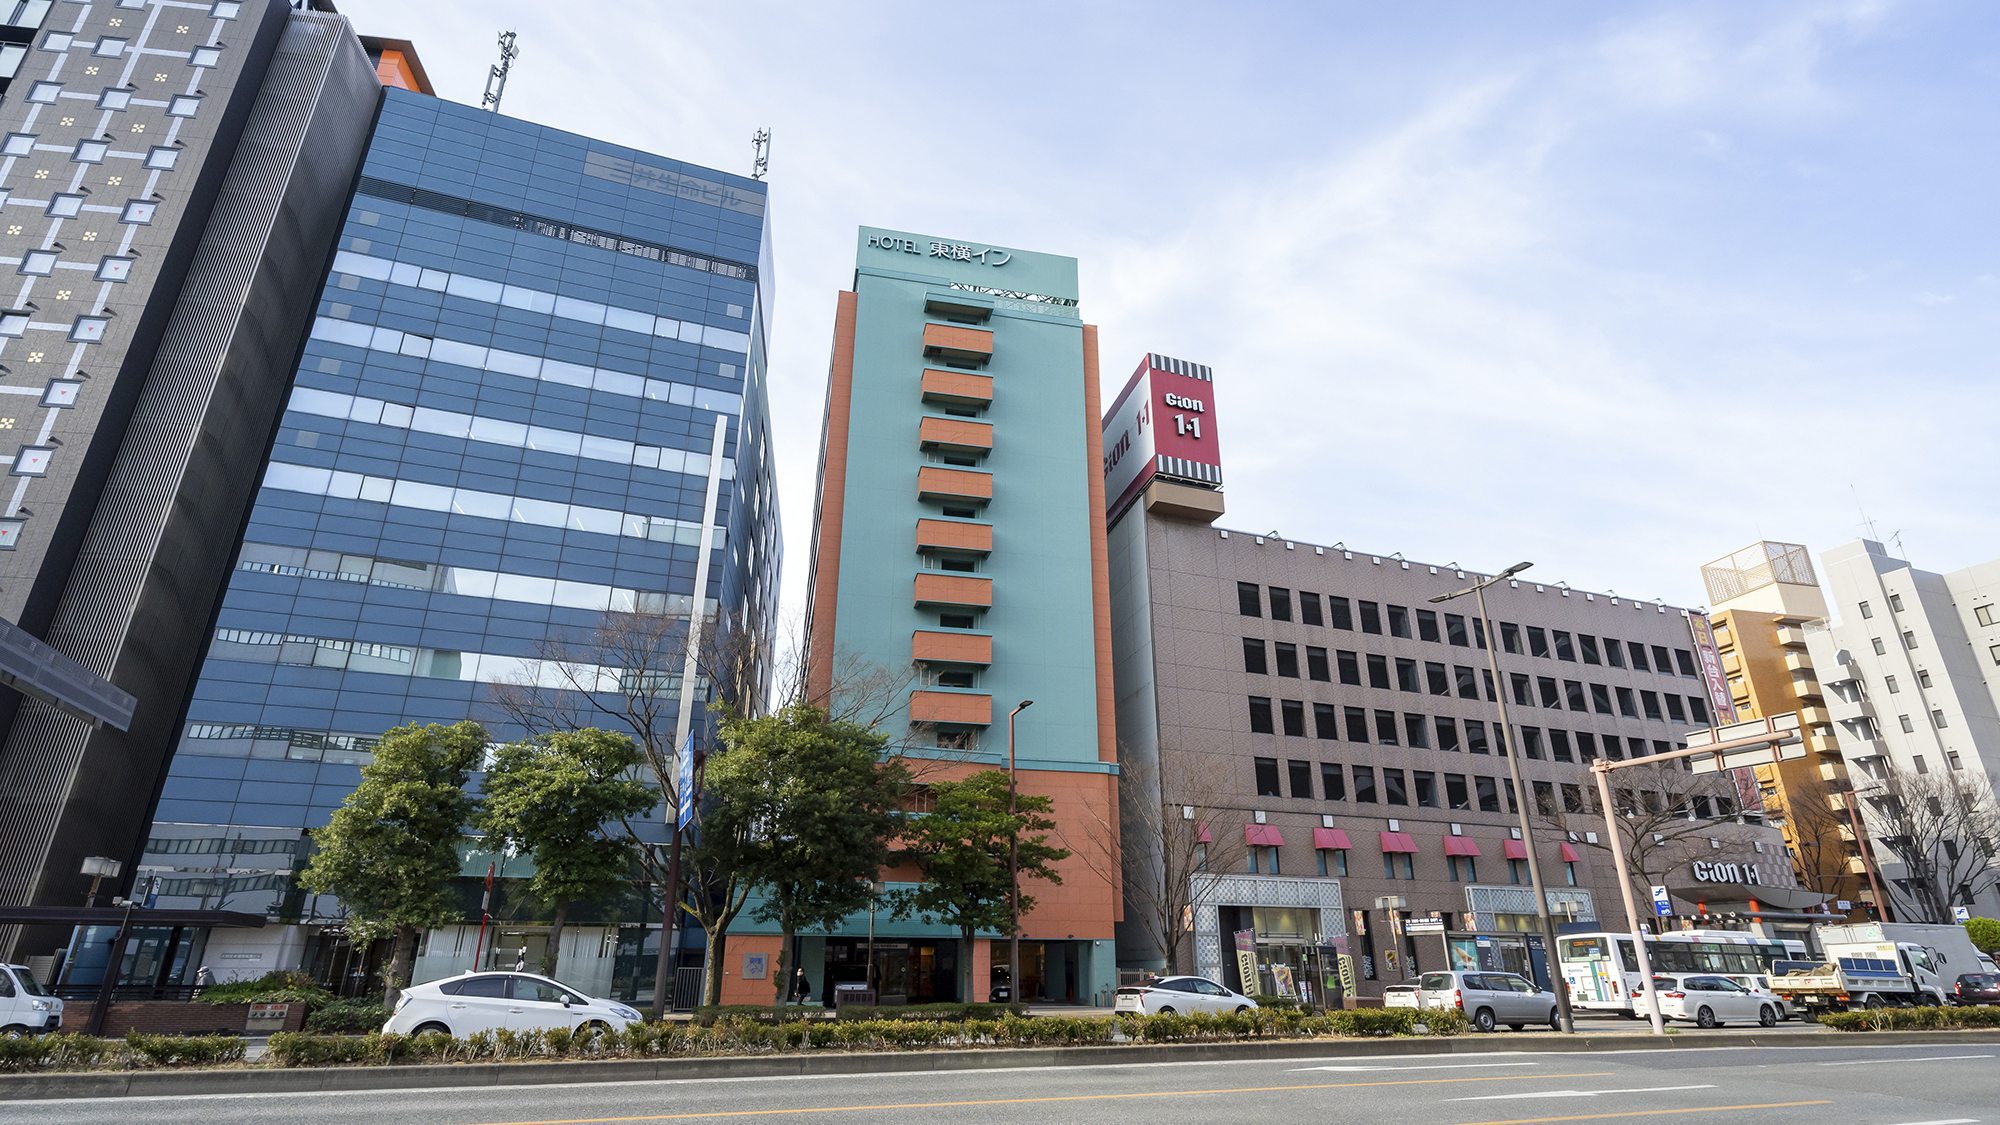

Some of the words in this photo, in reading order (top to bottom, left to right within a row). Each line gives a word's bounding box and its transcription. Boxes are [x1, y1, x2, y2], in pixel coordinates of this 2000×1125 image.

[867, 234, 921, 255] HOTEL
[929, 240, 1012, 266] 東横イン
